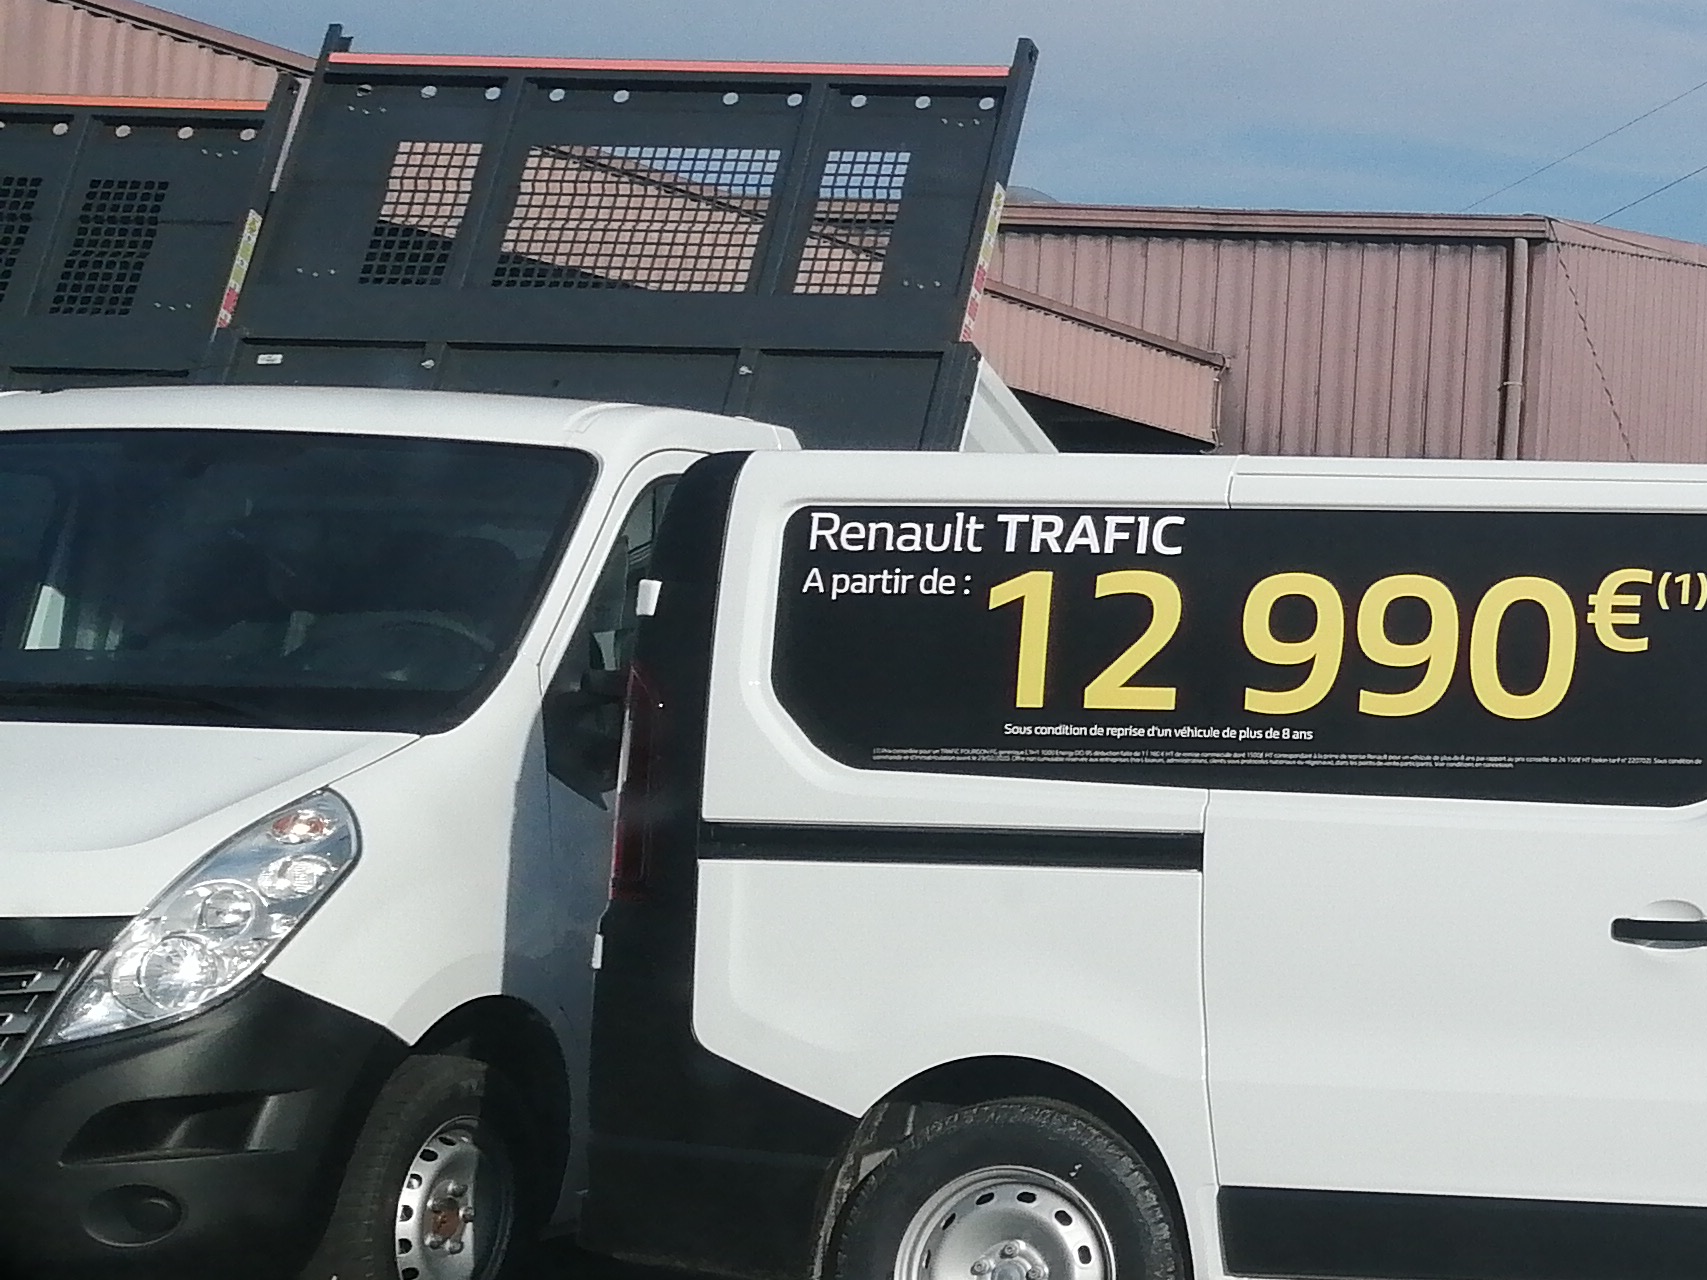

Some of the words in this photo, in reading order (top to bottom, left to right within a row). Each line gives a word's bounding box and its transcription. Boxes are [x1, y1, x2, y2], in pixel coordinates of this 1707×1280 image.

[809, 511, 984, 553] Renault
[996, 513, 1186, 556] TRAFIC
[801, 567, 825, 594] A
[831, 567, 915, 601] partir
[920, 567, 956, 595] de
[987, 569, 1183, 711] 12
[1003, 723, 1033, 735] Sous
[1034, 724, 1088, 736] condition
[1089, 724, 1105, 736] de
[1106, 725, 1146, 739] reprise
[1147, 725, 1172, 738] d'un
[1174, 725, 1220, 738] véhicule
[1221, 726, 1237, 739] de
[1238, 727, 1263, 741] plus
[1265, 727, 1280, 740] de
[1281, 727, 1291, 740] 8
[1292, 730, 1314, 740] ans
